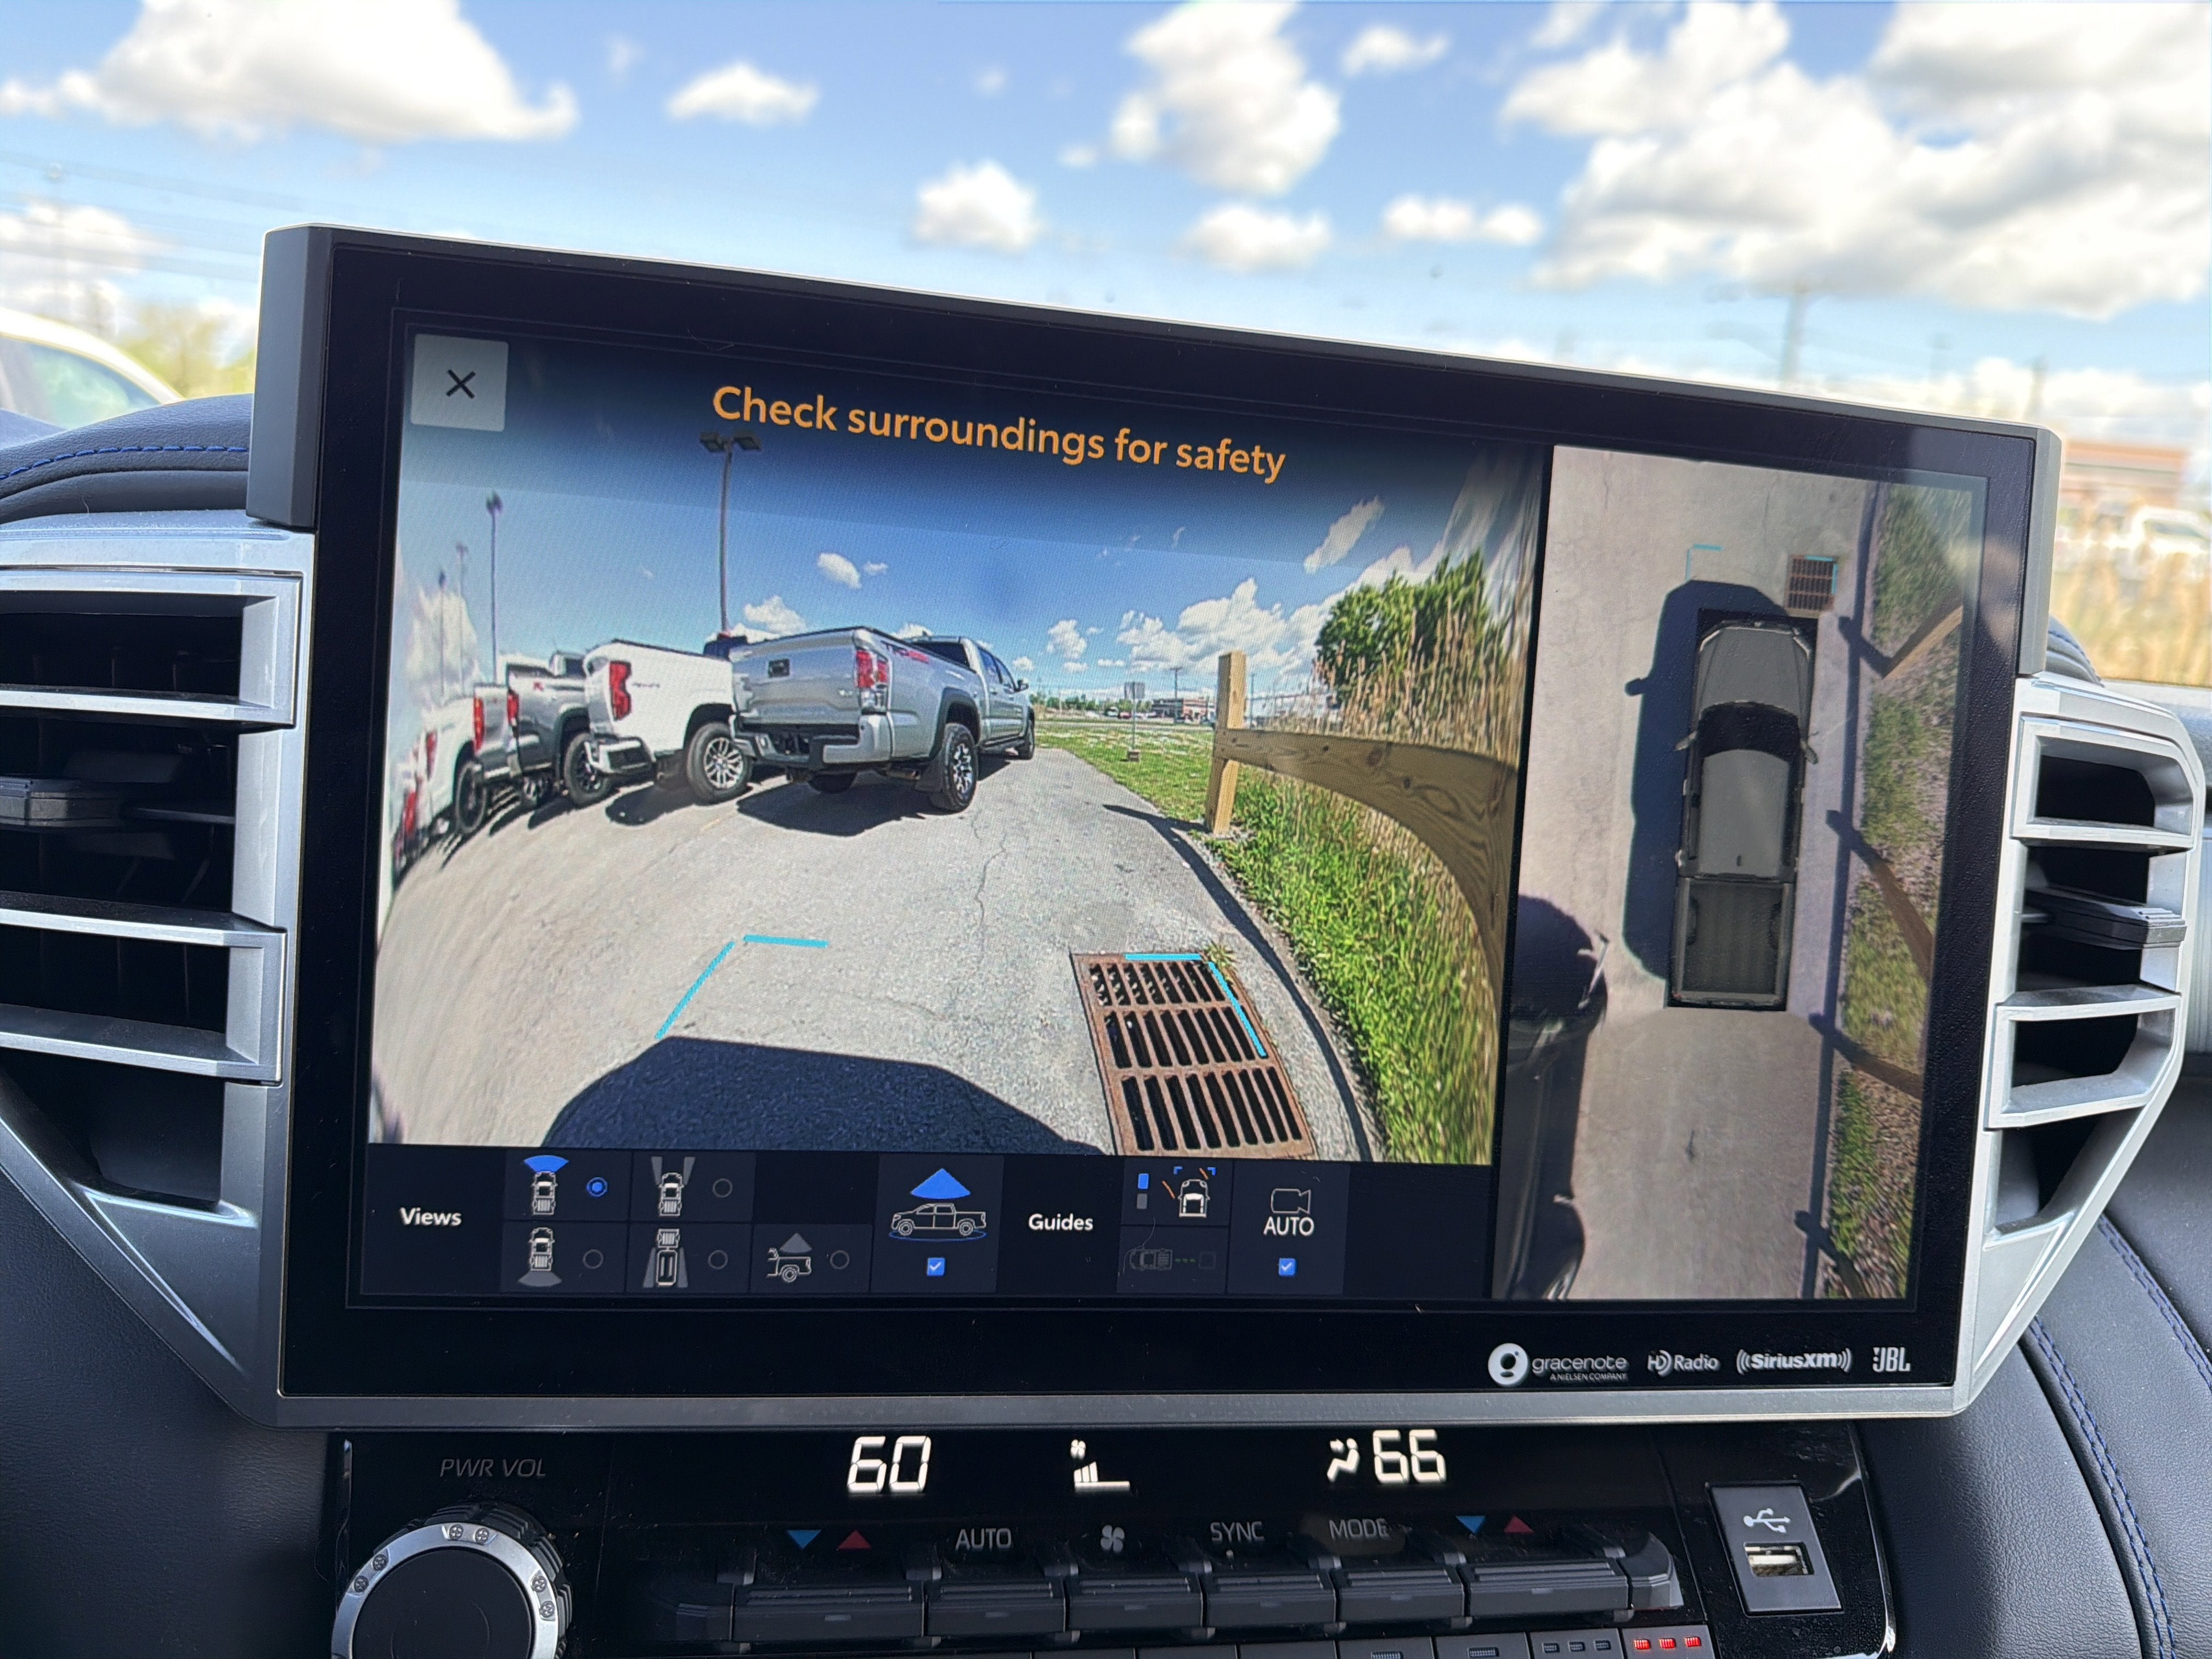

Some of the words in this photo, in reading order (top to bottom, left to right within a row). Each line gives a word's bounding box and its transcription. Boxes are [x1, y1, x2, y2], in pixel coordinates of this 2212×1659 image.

[712, 385, 838, 432] Check
[847, 408, 1106, 466] surroundings
[1114, 426, 1170, 466] for
[1176, 437, 1288, 486] safety
[399, 1206, 462, 1227] Views
[1028, 1212, 1094, 1231] Guides
[1262, 1215, 1315, 1237] AUTO
[1532, 1355, 1628, 1374] gracenote
[1673, 1353, 1720, 1372] Radio
[1873, 1347, 1911, 1373] JBL
[1589, 1372, 1628, 1381] COMPANY
[847, 1435, 932, 1493] 60
[1372, 1429, 1447, 1483] 66
[439, 1458, 493, 1478] PWR
[501, 1458, 546, 1478] VOL
[955, 1527, 1012, 1551] AUTO
[1210, 1520, 1265, 1543] SYNC
[1329, 1518, 1390, 1541] MODE
